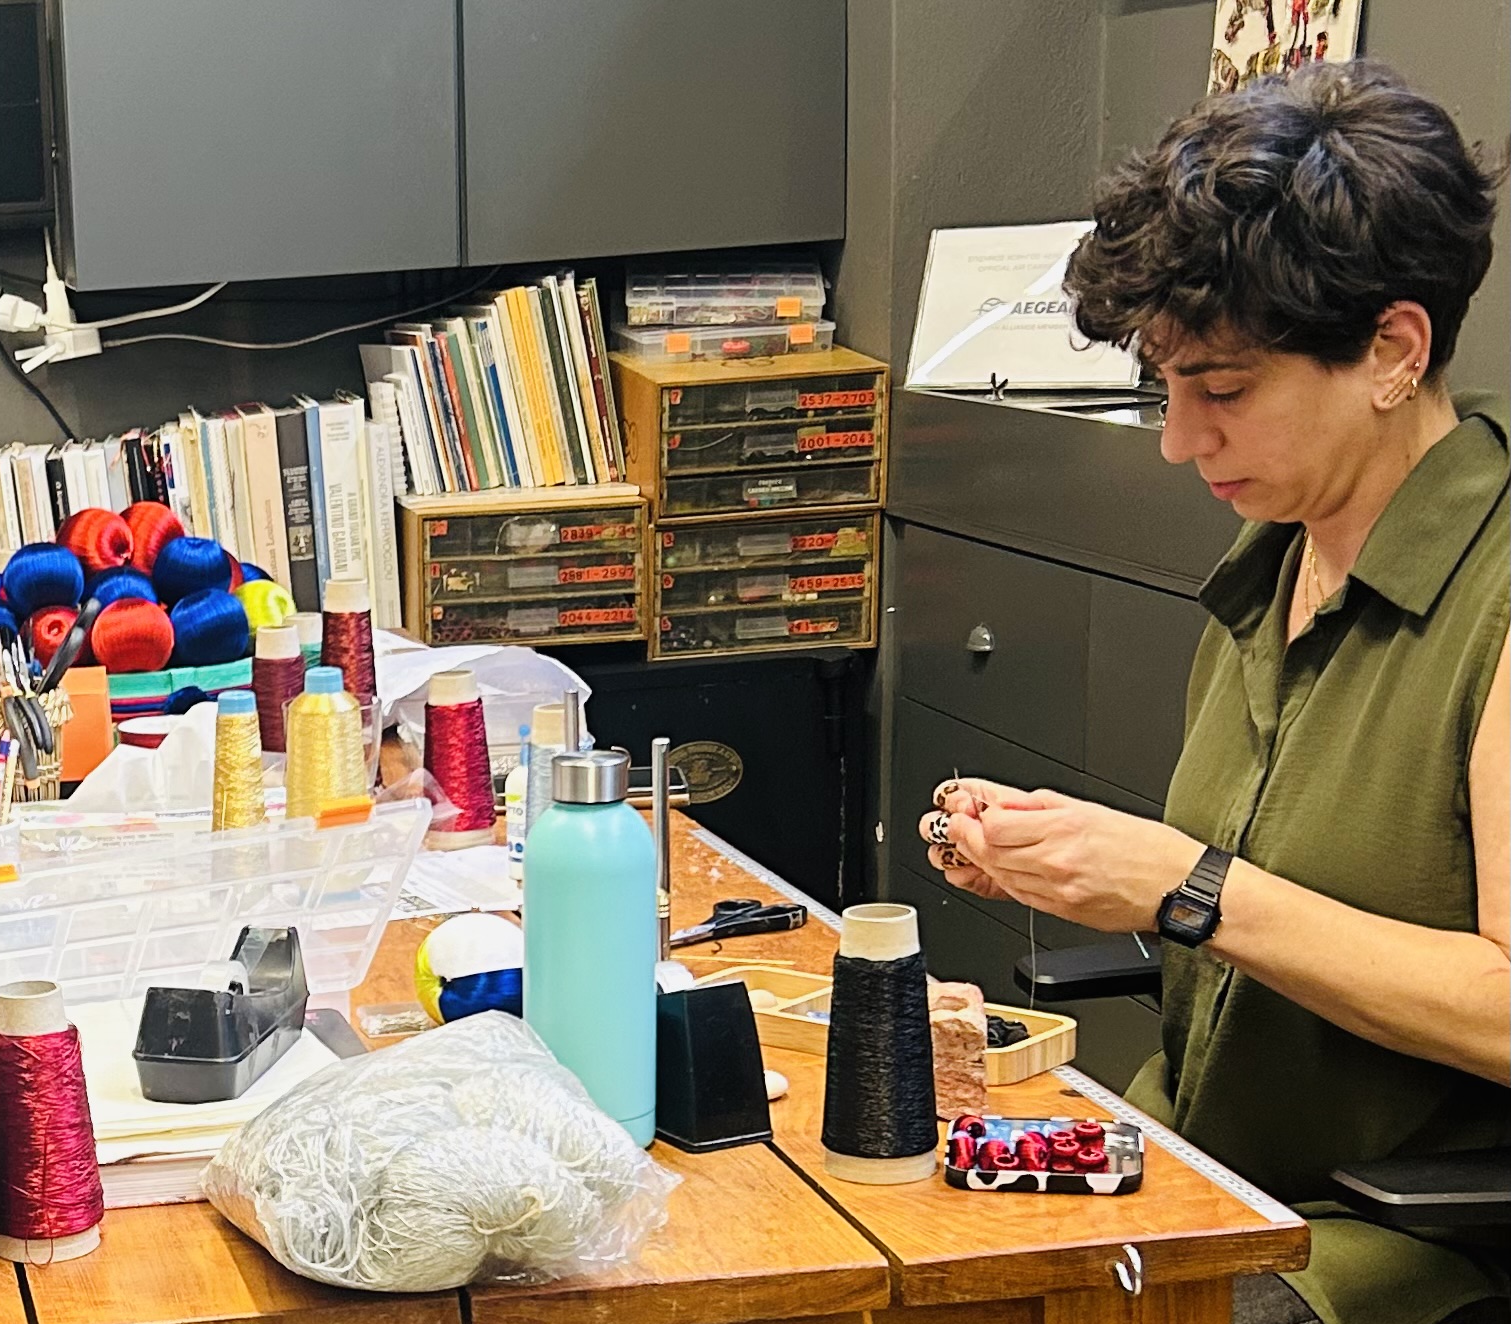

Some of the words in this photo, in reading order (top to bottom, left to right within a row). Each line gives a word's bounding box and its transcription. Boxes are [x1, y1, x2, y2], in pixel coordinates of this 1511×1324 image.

[800, 391, 875, 407] 2537-2703
[800, 432, 875, 449] 2001-2043
[329, 483, 346, 529] VALENTINO
[332, 530, 348, 574] GARAVANI
[561, 610, 634, 625] 2044-2214
